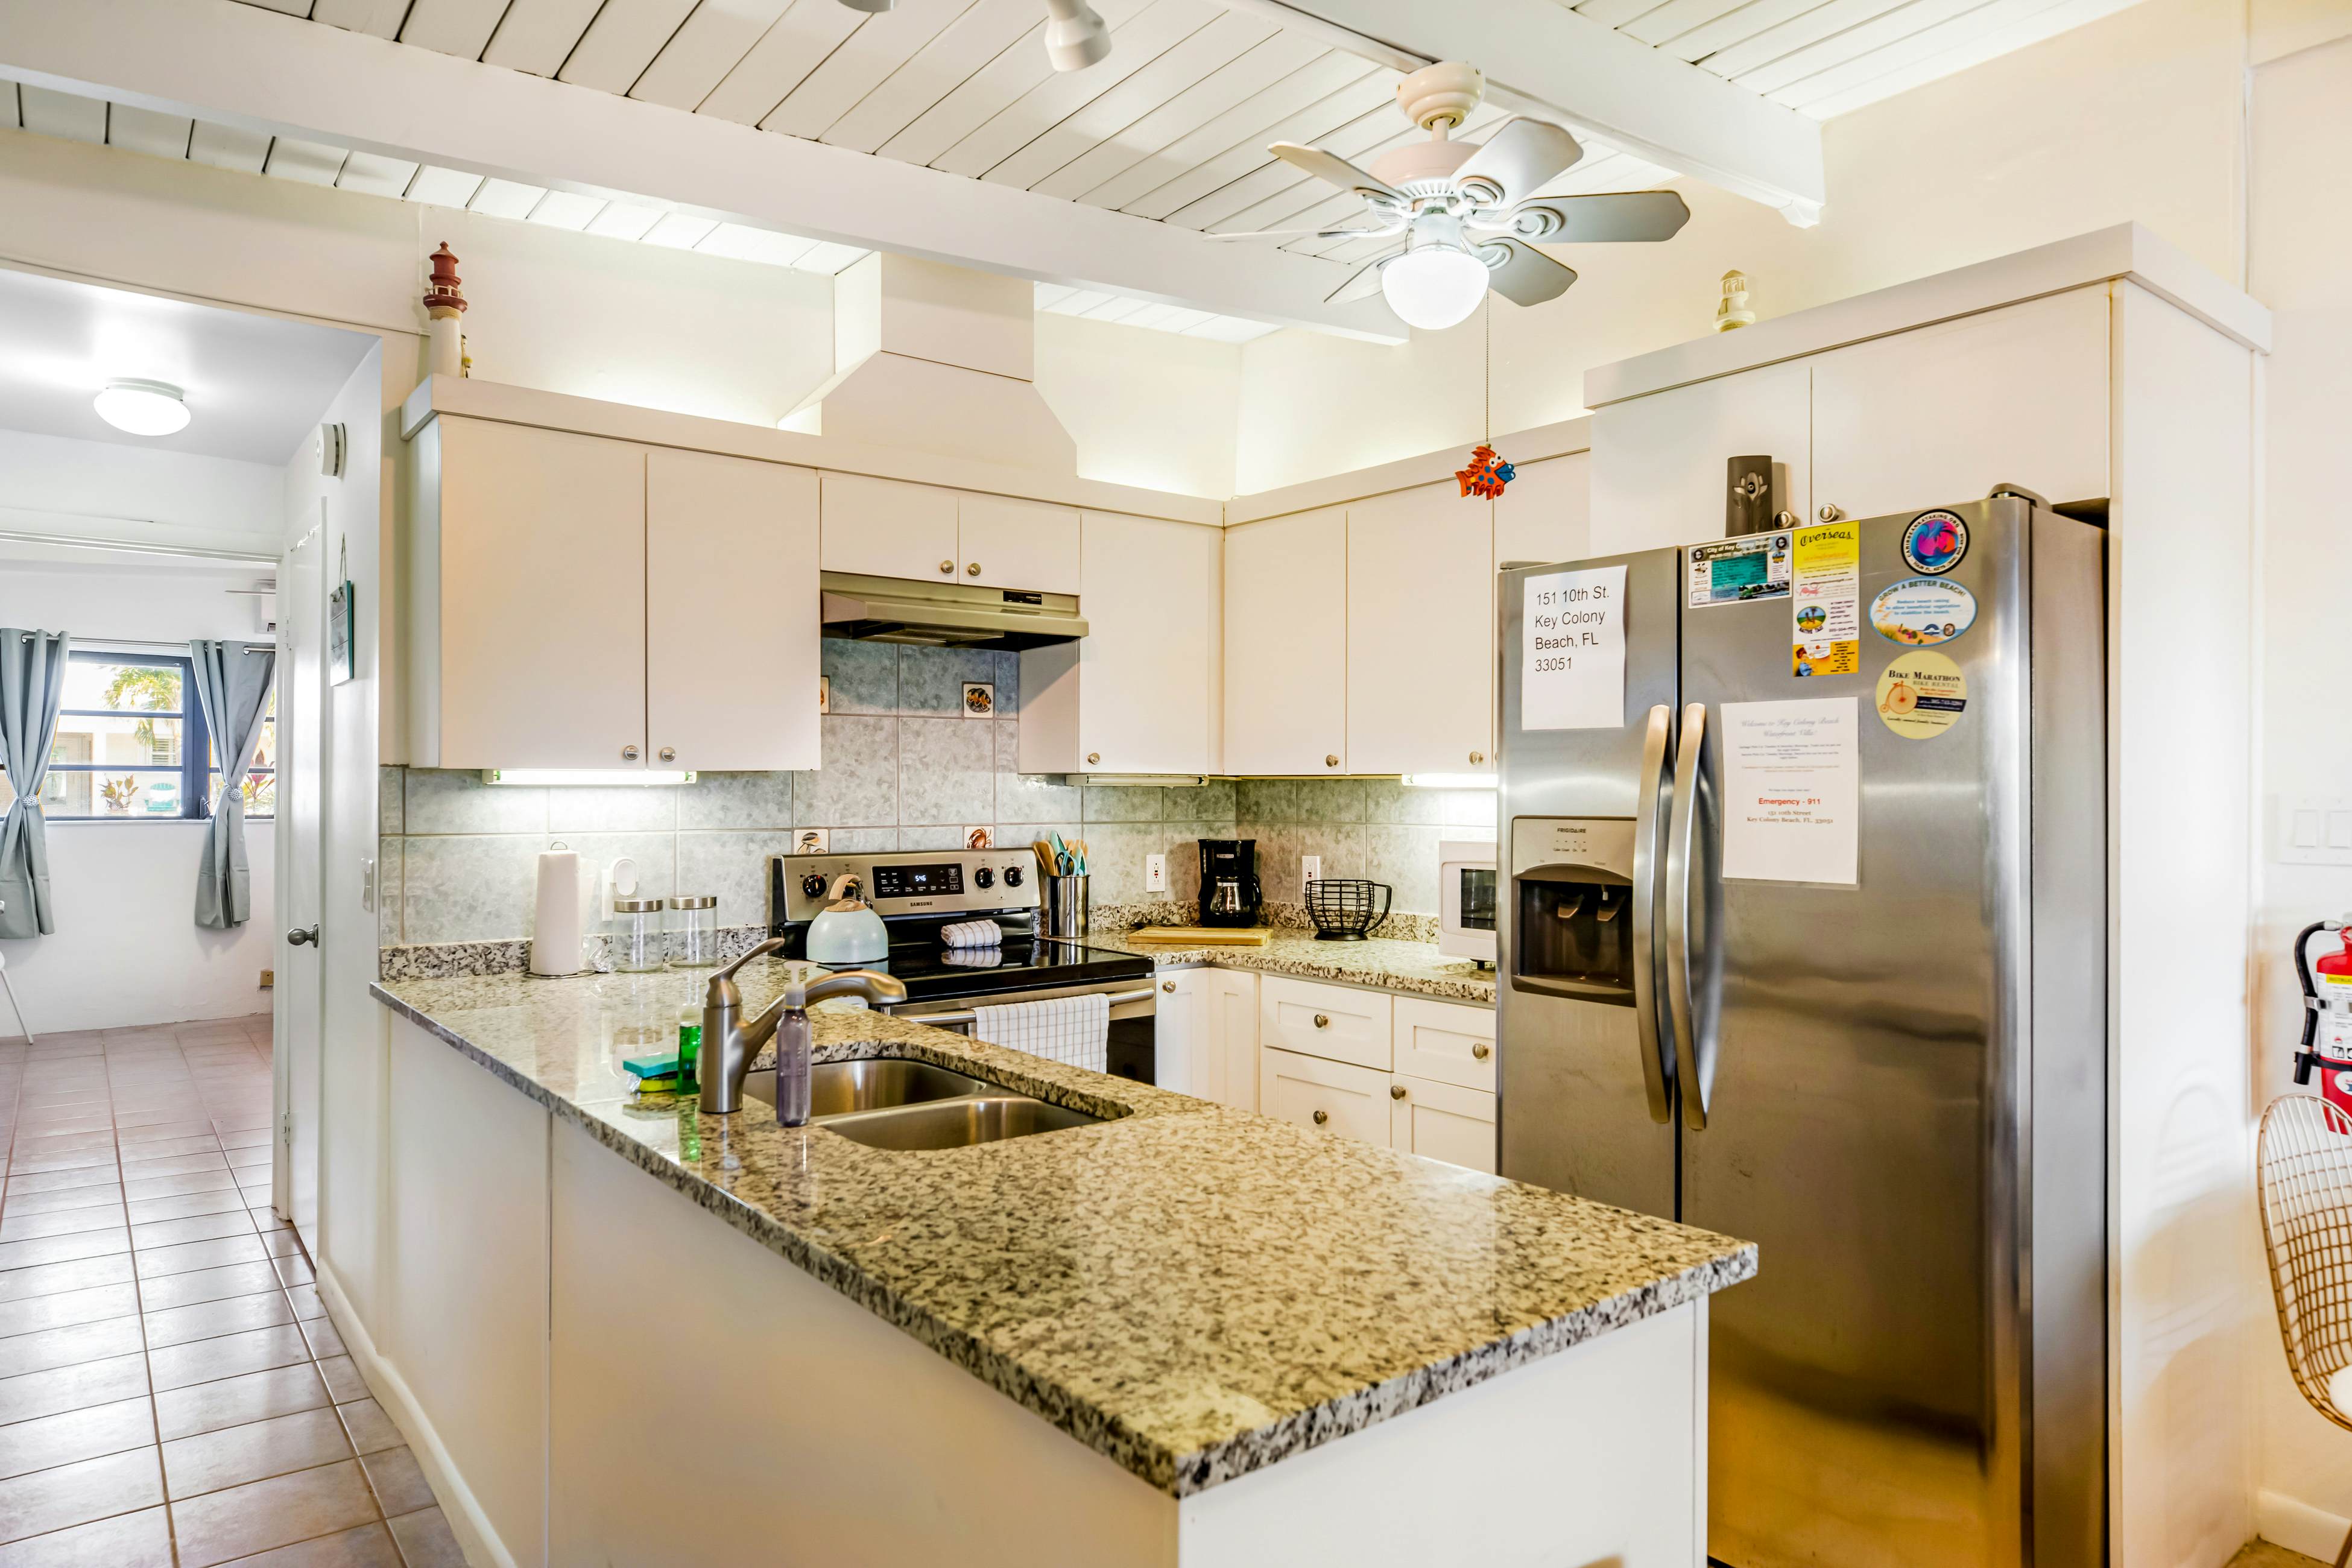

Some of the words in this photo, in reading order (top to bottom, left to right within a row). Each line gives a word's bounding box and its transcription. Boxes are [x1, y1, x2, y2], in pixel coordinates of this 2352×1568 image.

[1800, 531, 1854, 546] Overseas
[1537, 592, 1557, 605] 151
[1563, 588, 1589, 603] 10th
[1593, 586, 1610, 599] St.
[1879, 587, 1899, 601] GROW
[1939, 581, 1967, 597] BEACH!
[1535, 615, 1558, 630] Key
[1562, 610, 1605, 625] Colony
[1535, 635, 1578, 650] Beach,
[1582, 633, 1599, 646] FL
[1535, 657, 1572, 672] 33051
